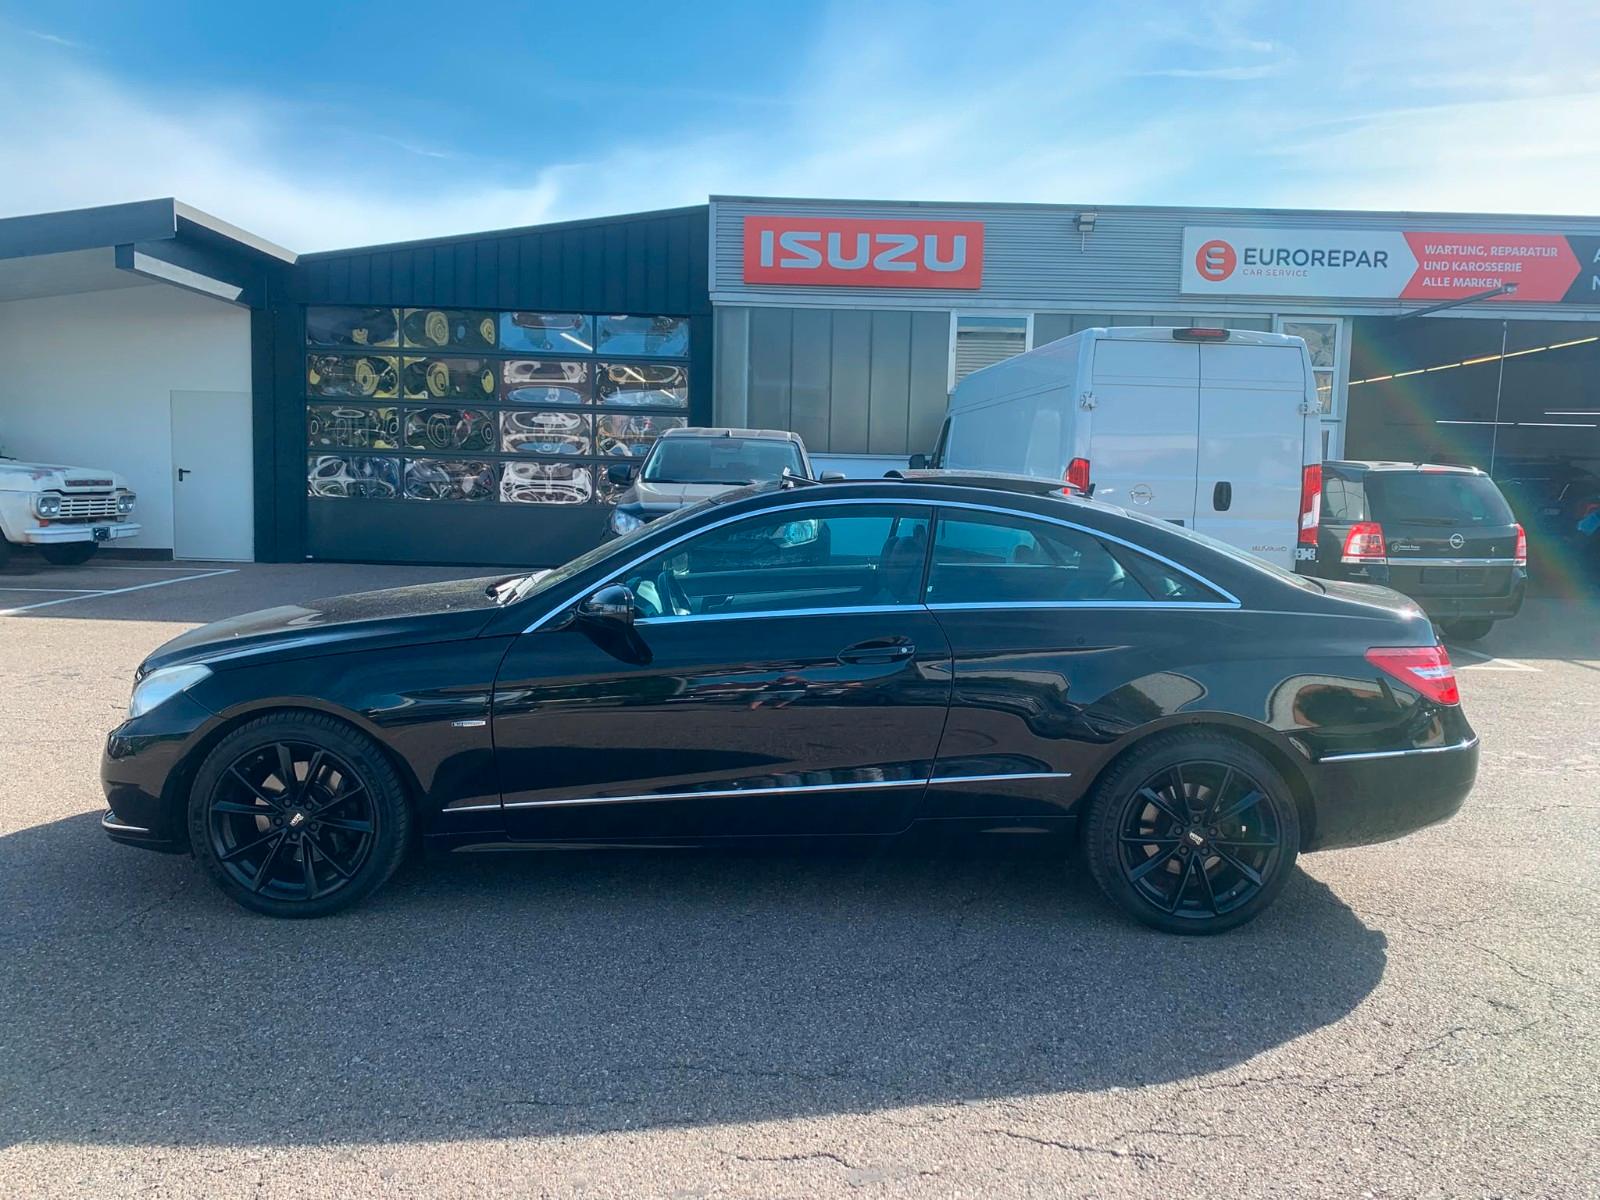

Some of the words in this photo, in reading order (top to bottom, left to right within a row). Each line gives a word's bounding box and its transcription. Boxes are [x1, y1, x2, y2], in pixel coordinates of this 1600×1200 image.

[760, 230, 967, 272] ISUZU
[1424, 245, 1487, 256] WARTUNG,
[1491, 246, 1558, 256] REPARATUR
[1244, 248, 1388, 268] EUROREPAR
[1424, 262, 1448, 270] UND
[1452, 262, 1522, 272] KAROSSERIE
[1422, 277, 1450, 286] ALLE
[1453, 278, 1502, 288] MARKEN
